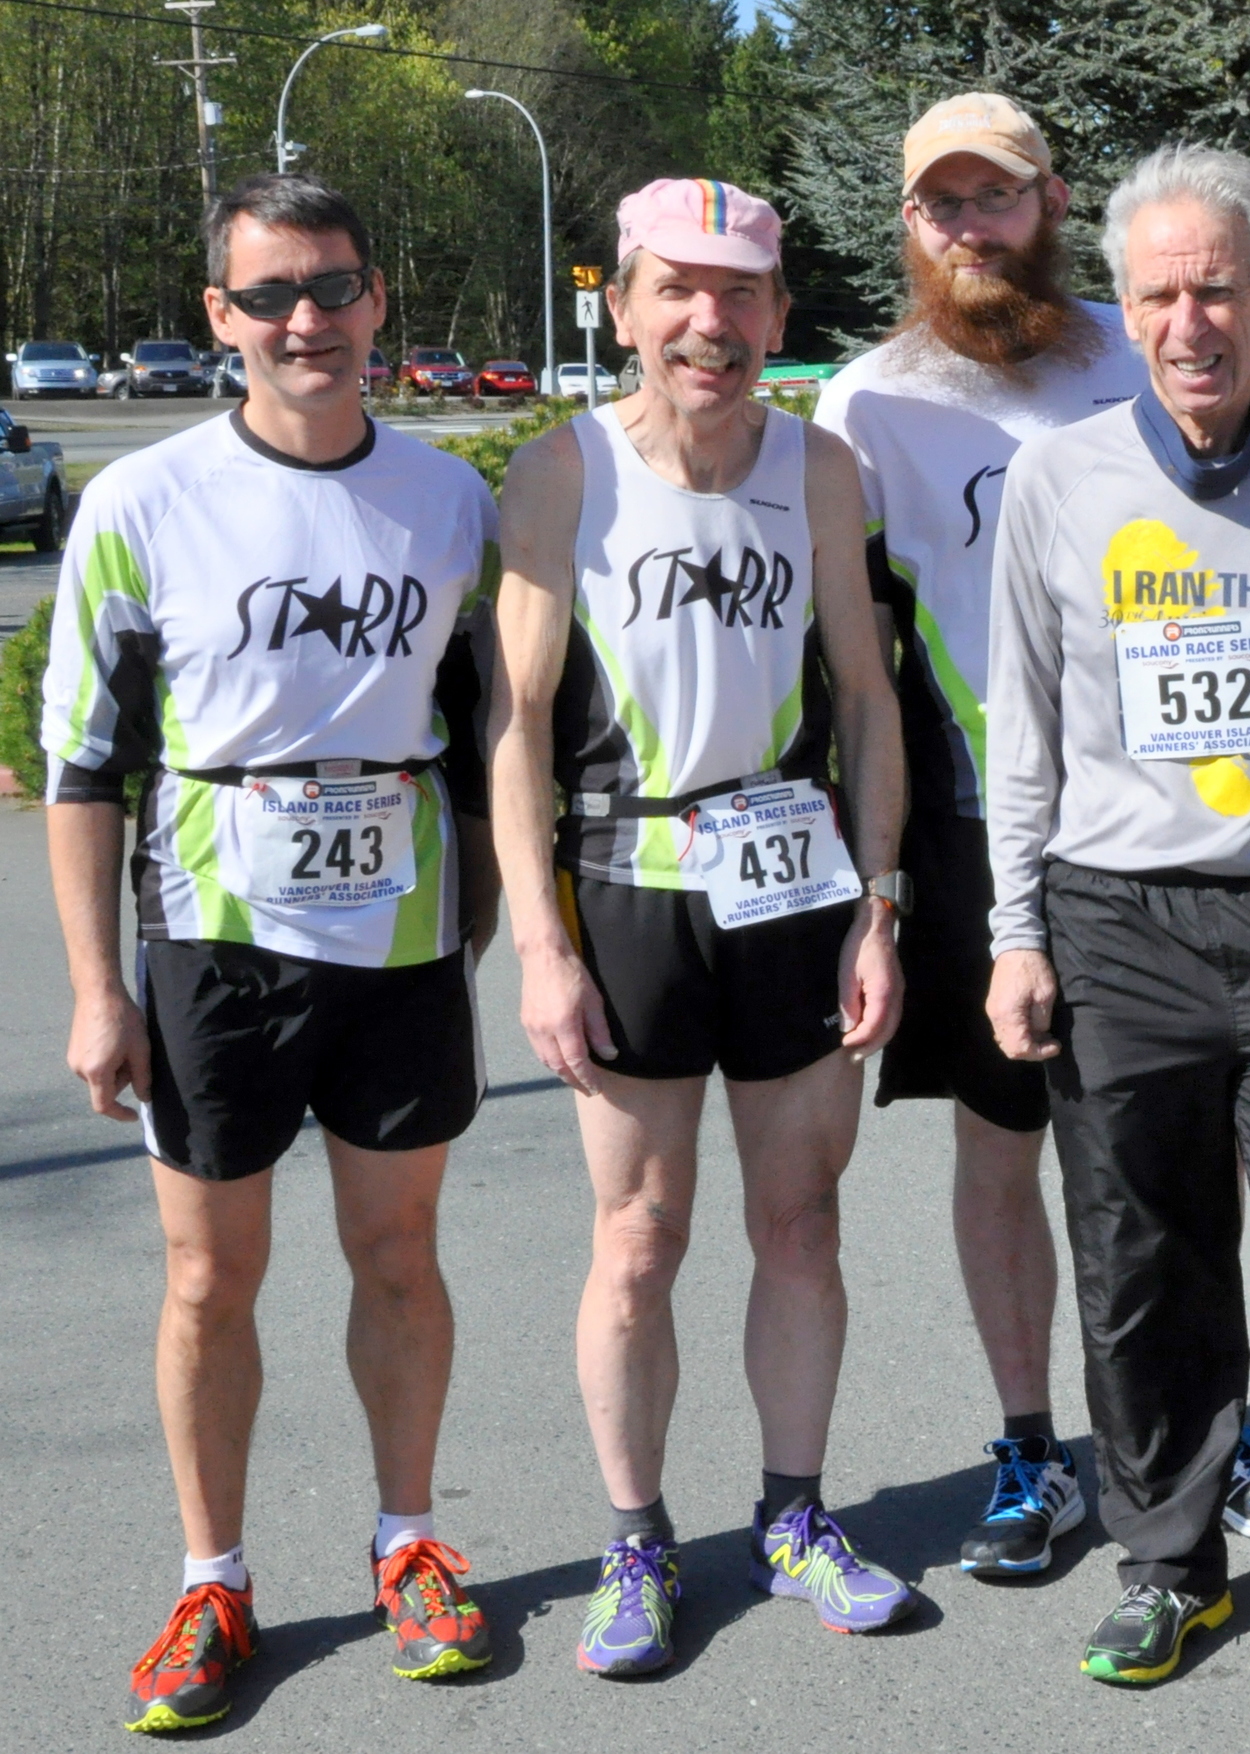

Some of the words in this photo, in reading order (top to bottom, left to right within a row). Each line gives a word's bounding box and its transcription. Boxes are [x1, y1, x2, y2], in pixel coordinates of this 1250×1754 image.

[1113, 570, 1122, 604] I
[1134, 570, 1206, 607] RAN
[1125, 644, 1181, 660] ISLAND
[1185, 640, 1225, 655] RACE
[1150, 727, 1222, 742] VANCOUVER
[1140, 742, 1199, 754] RUNNERS'
[262, 800, 319, 814] ISLAND
[324, 800, 362, 813] RACE
[366, 793, 402, 811] SERIES
[698, 813, 751, 836] ISLAND
[754, 804, 788, 823] RACE
[789, 799, 826, 816] SERIES
[291, 825, 384, 880] 243
[739, 829, 812, 889] 437
[266, 891, 326, 905] RUNNERS'
[329, 884, 404, 901] ASSOCIATION
[279, 882, 351, 896] VANCOUVER
[354, 878, 393, 892] ISLAND
[735, 887, 800, 910] VANCOUVER
[802, 879, 838, 895] ISLAND
[727, 902, 783, 923] RUNNERS'
[786, 886, 851, 910] ASSOCIATION
